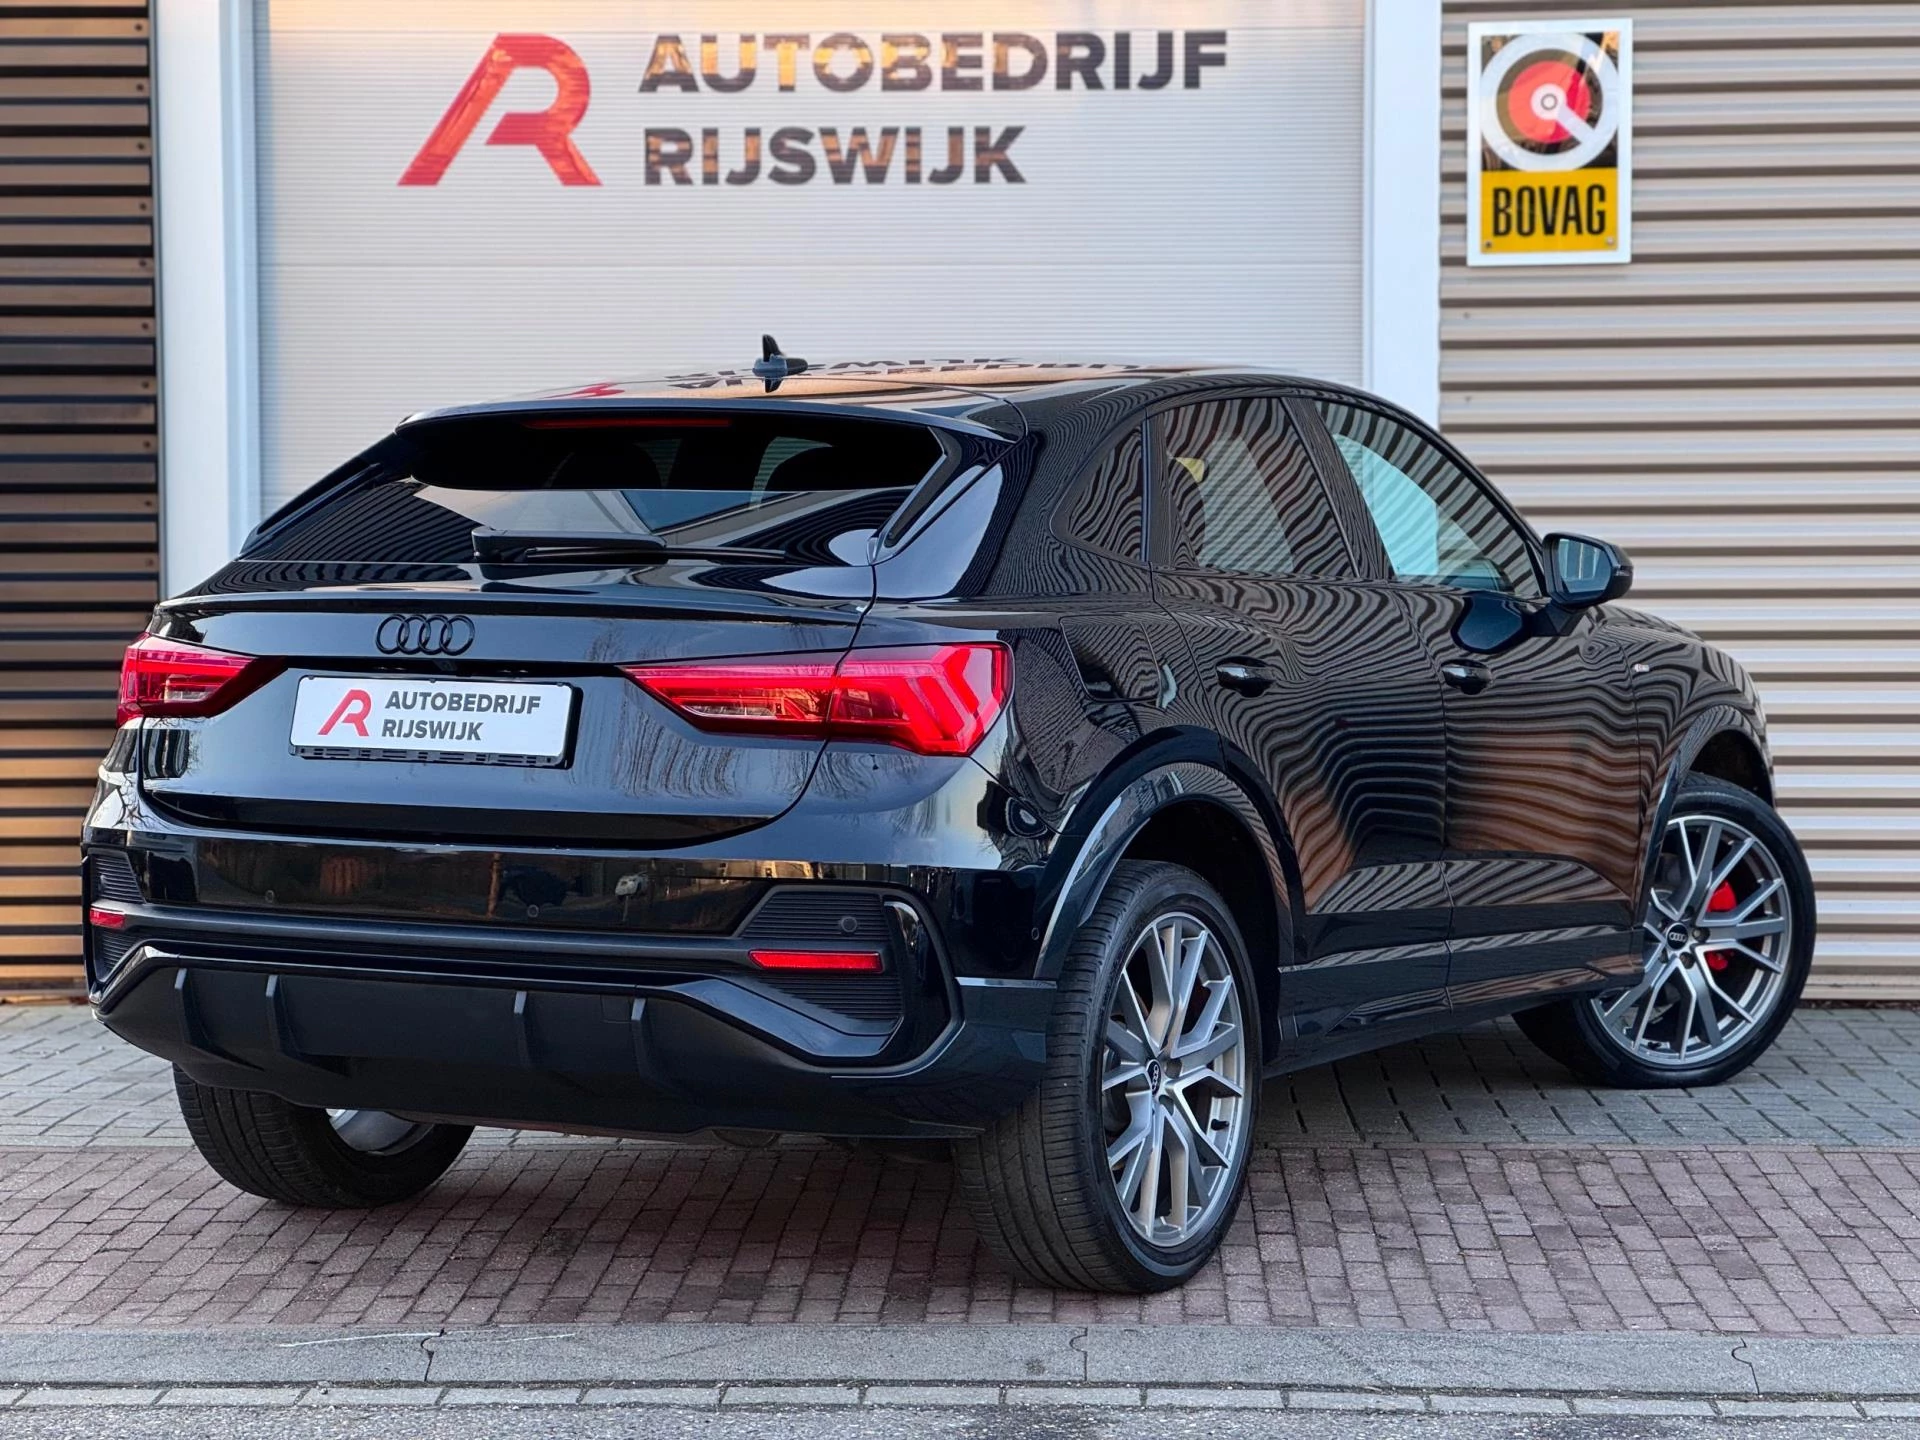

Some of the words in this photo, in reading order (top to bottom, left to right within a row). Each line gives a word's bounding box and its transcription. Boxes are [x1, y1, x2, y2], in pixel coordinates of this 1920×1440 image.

[638, 32, 1227, 92] AUTOBEDRIJF
[644, 126, 1027, 186] RIJSWIJK
[1493, 184, 1606, 237] BOVAG
[385, 690, 541, 714] AUTOBEDRIJF
[382, 719, 483, 741] RIJSWIJK
